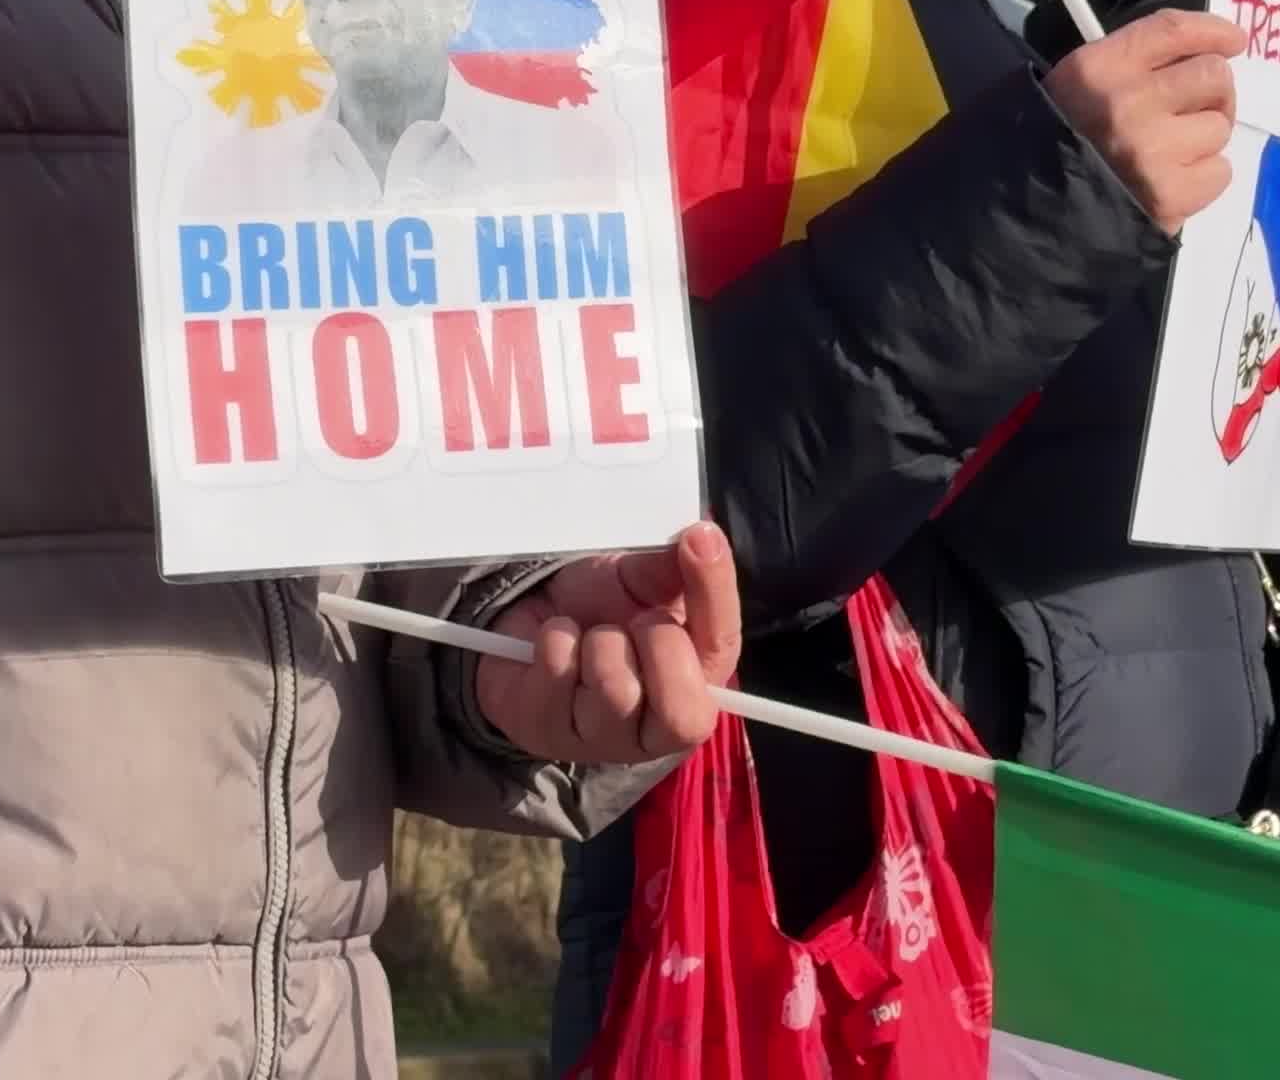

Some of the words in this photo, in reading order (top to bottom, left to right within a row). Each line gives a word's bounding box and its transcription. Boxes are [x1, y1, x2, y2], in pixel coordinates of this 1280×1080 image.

[177, 217, 439, 314] BRING
[476, 211, 631, 301] HIM
[184, 304, 651, 465] HOME
